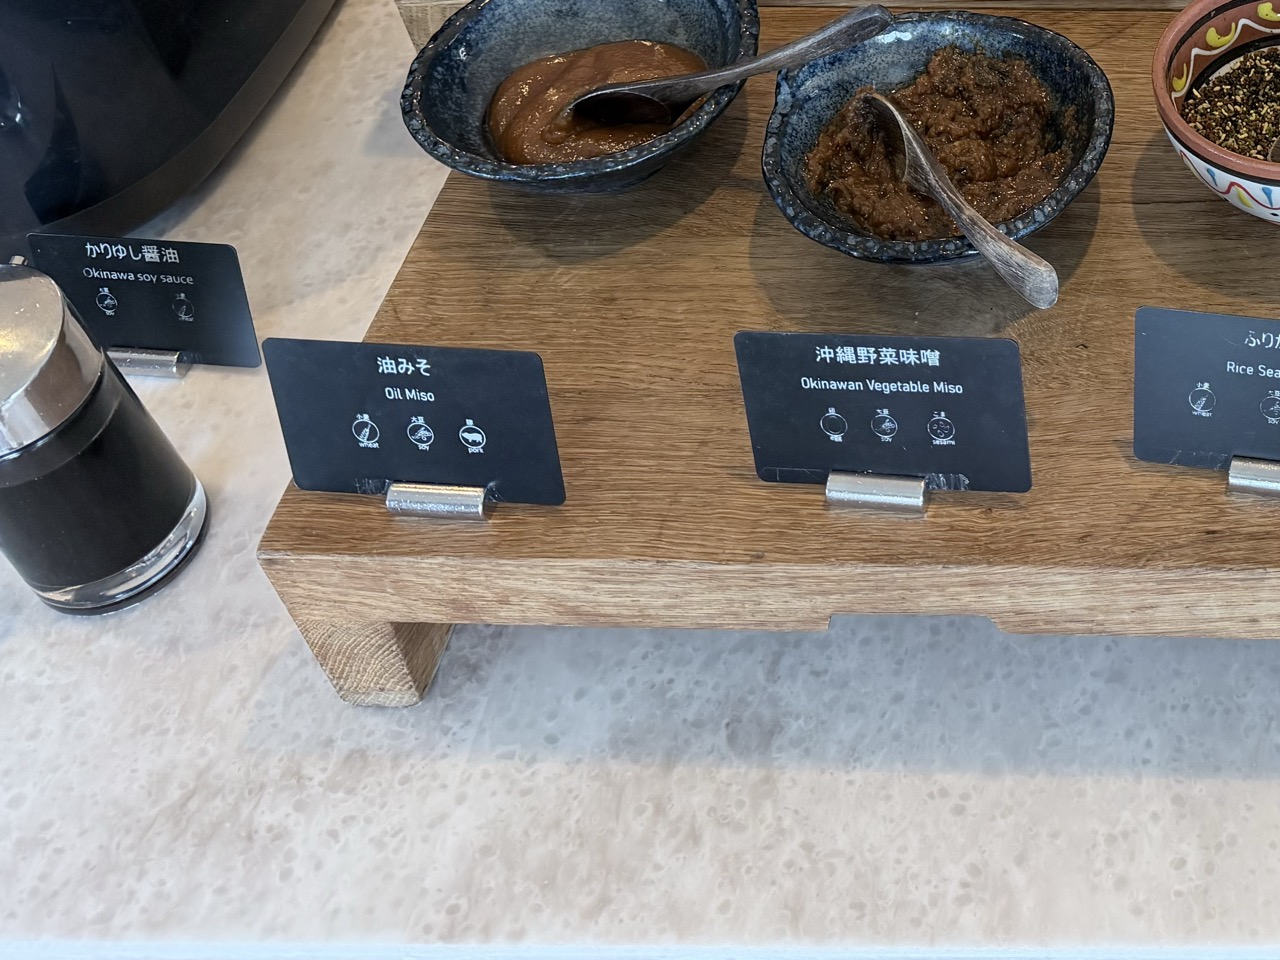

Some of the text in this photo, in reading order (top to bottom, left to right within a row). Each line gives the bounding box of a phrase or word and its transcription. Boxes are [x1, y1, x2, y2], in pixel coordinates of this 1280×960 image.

[85, 241, 181, 263] かりゆし醤油
[83, 268, 194, 284] Okinawa soy sauce
[816, 346, 940, 366] 沖縄野菜味噌
[377, 356, 430, 376] 油みそ
[1226, 361, 1254, 375] Rice
[384, 387, 435, 401] Oil Miso
[801, 377, 963, 394] Okinawan Vegetable Miso
